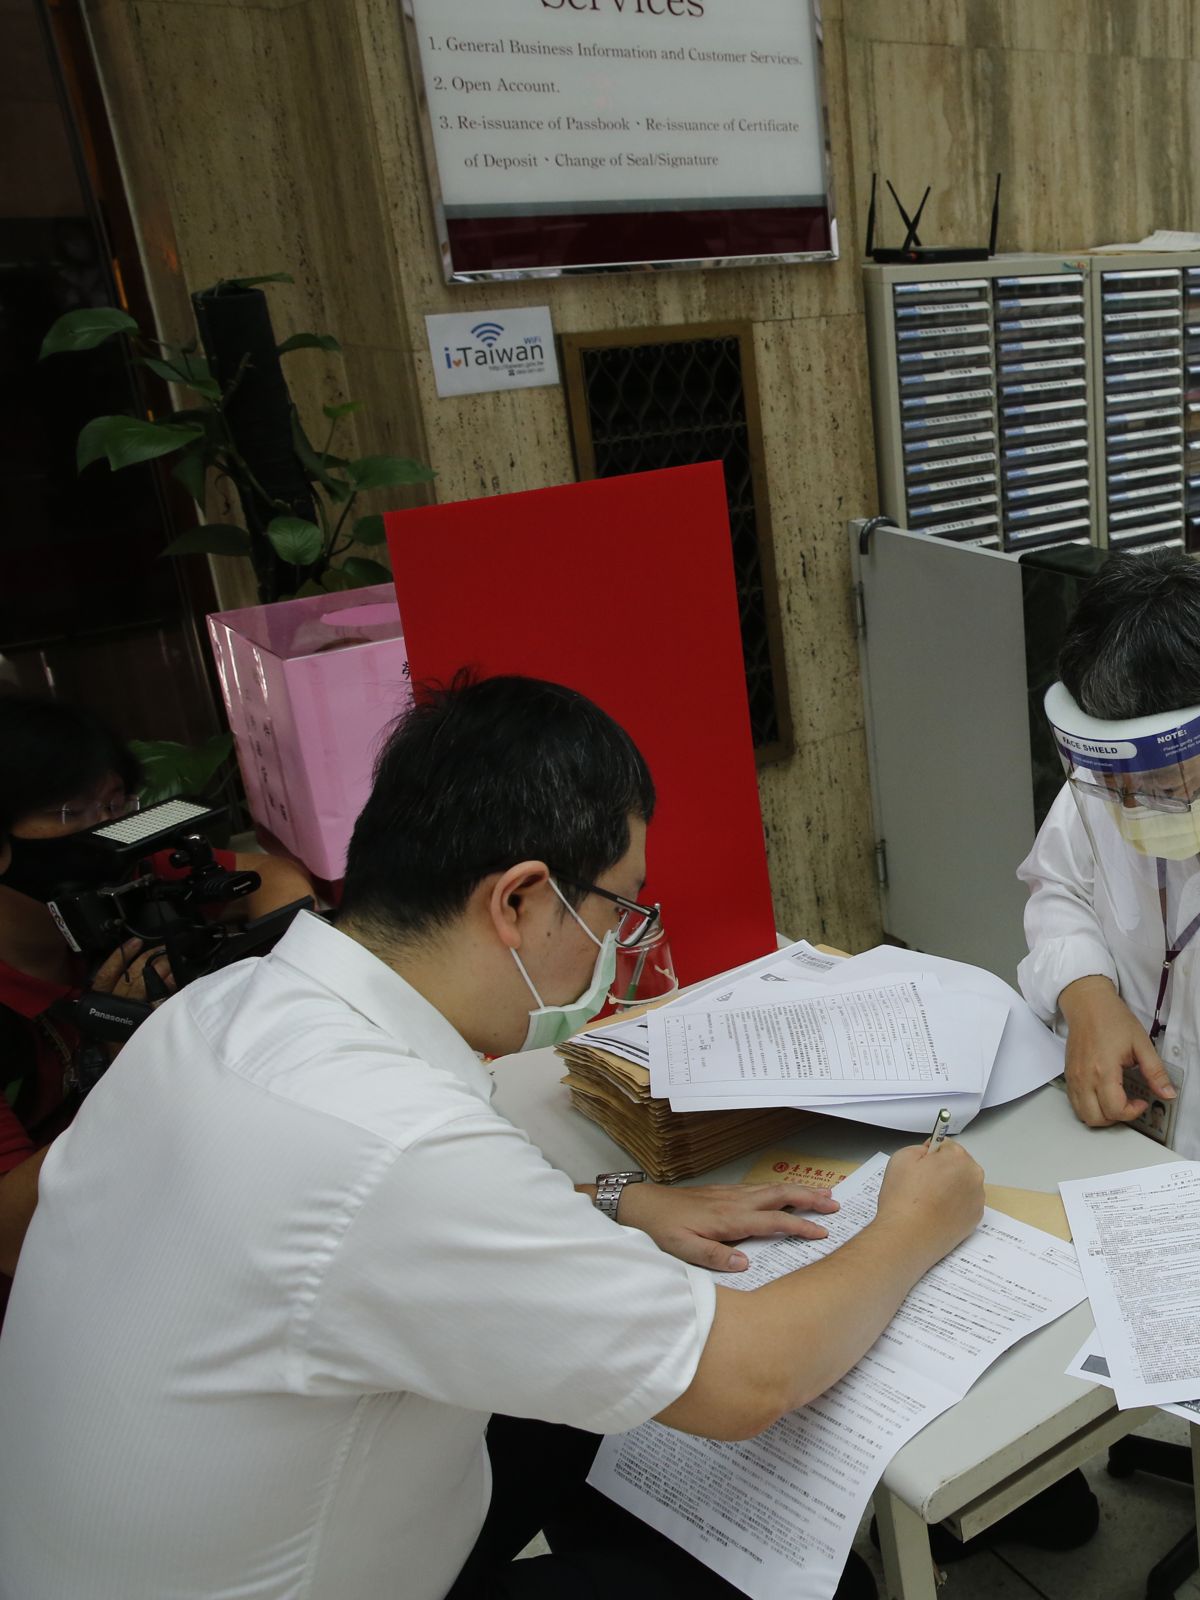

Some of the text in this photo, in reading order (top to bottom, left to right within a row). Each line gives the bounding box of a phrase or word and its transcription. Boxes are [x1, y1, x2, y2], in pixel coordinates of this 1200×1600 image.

[428, 36, 441, 51] 1.
[446, 37, 505, 53] General
[509, 39, 574, 57] Business
[577, 43, 657, 60] Information
[661, 47, 685, 61] and
[688, 48, 747, 63] Customer
[433, 76, 560, 94] 2. Open Account.
[439, 115, 799, 133] 3. Re-issuance of Passbook Re-issuance of Certificate
[464, 152, 719, 170] of Deposit Change of Seal/Signature
[1062, 736, 1118, 754] FACE SHIELD
[1156, 729, 1188, 744] NOTE:
[89, 1008, 133, 1025] Panasonic
